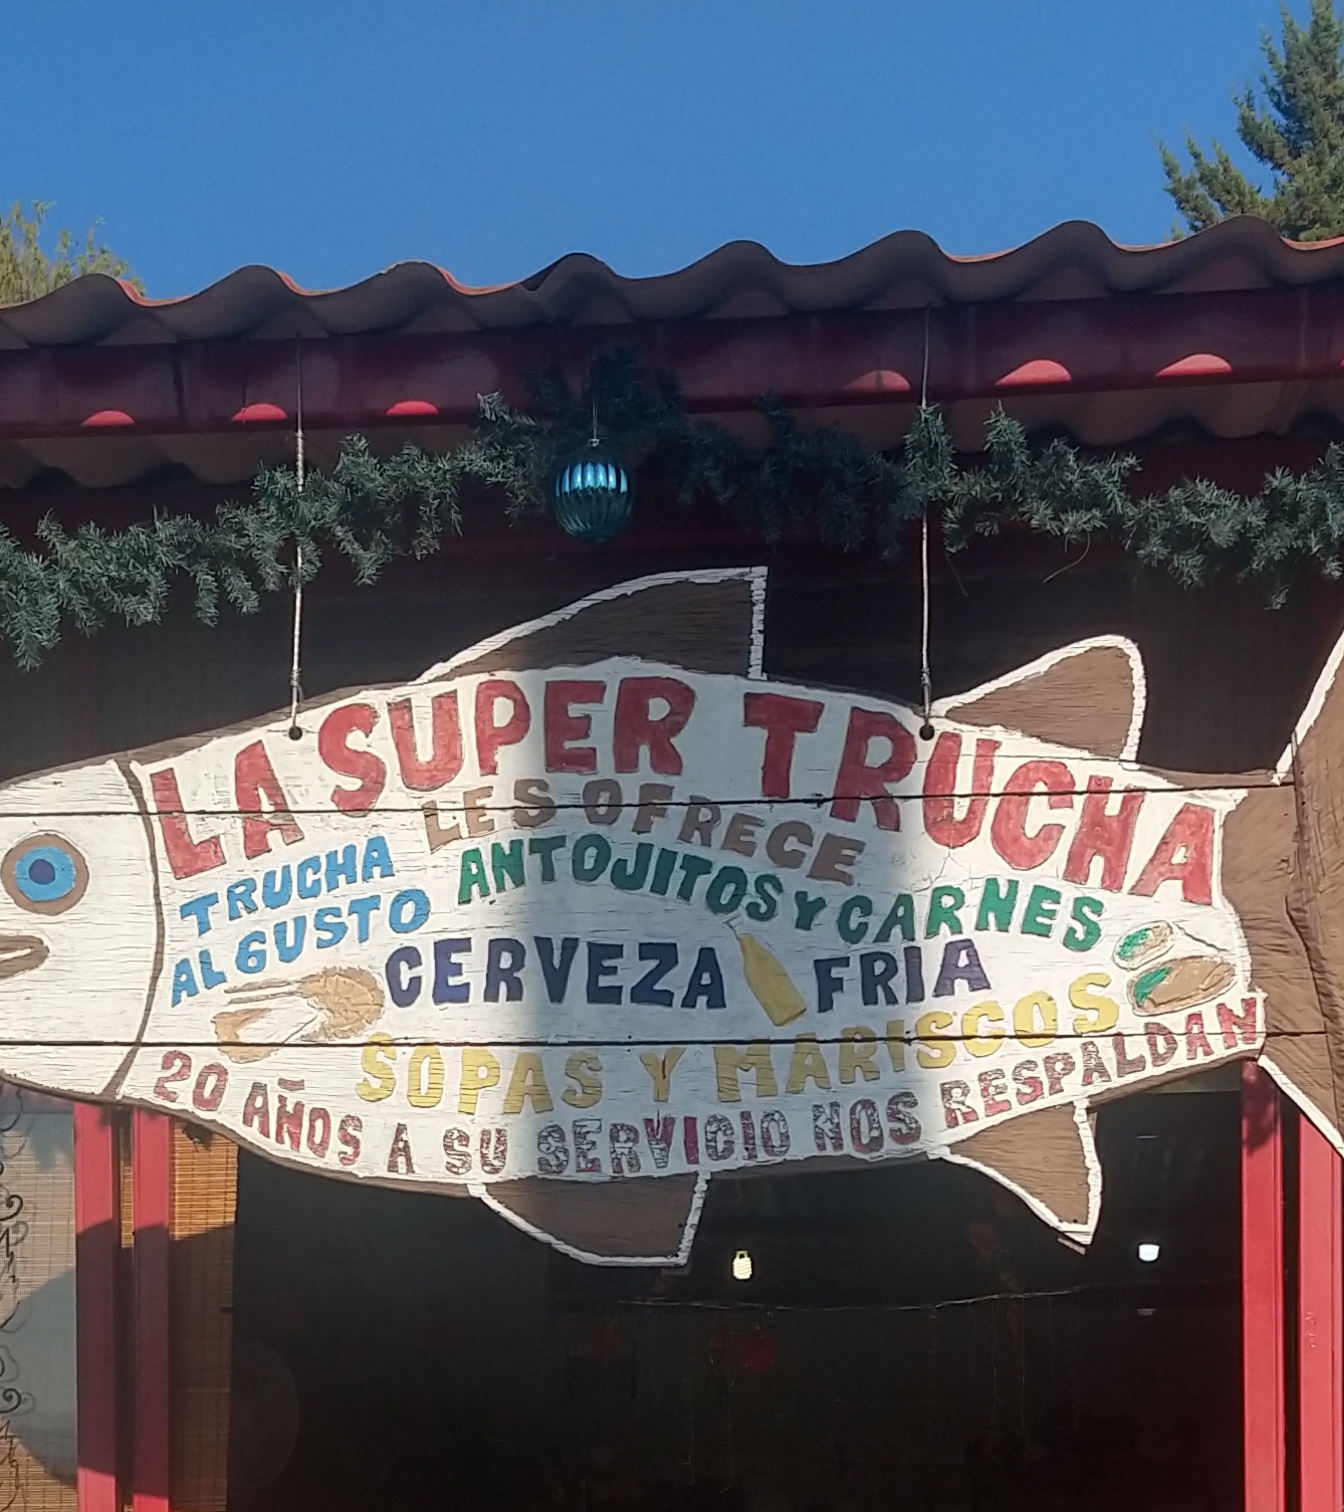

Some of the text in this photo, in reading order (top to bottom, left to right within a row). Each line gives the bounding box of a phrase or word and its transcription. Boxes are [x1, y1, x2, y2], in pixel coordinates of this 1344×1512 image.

[150, 676, 1216, 906] LA SUPER TRUCHA
[423, 778, 865, 886] LES OFRECE
[180, 837, 395, 937] TRUCHA
[457, 833, 1106, 954] ANTOJITOS Y CARNES
[170, 889, 432, 1007] AL GUSTO
[385, 936, 992, 1013] CERVEZA FRIA
[153, 996, 1261, 1176] 20 AÑOS A SU SERVICIO NOS RESPALDAN
[355, 973, 1120, 1115] SOPAS Y MARISCOS
